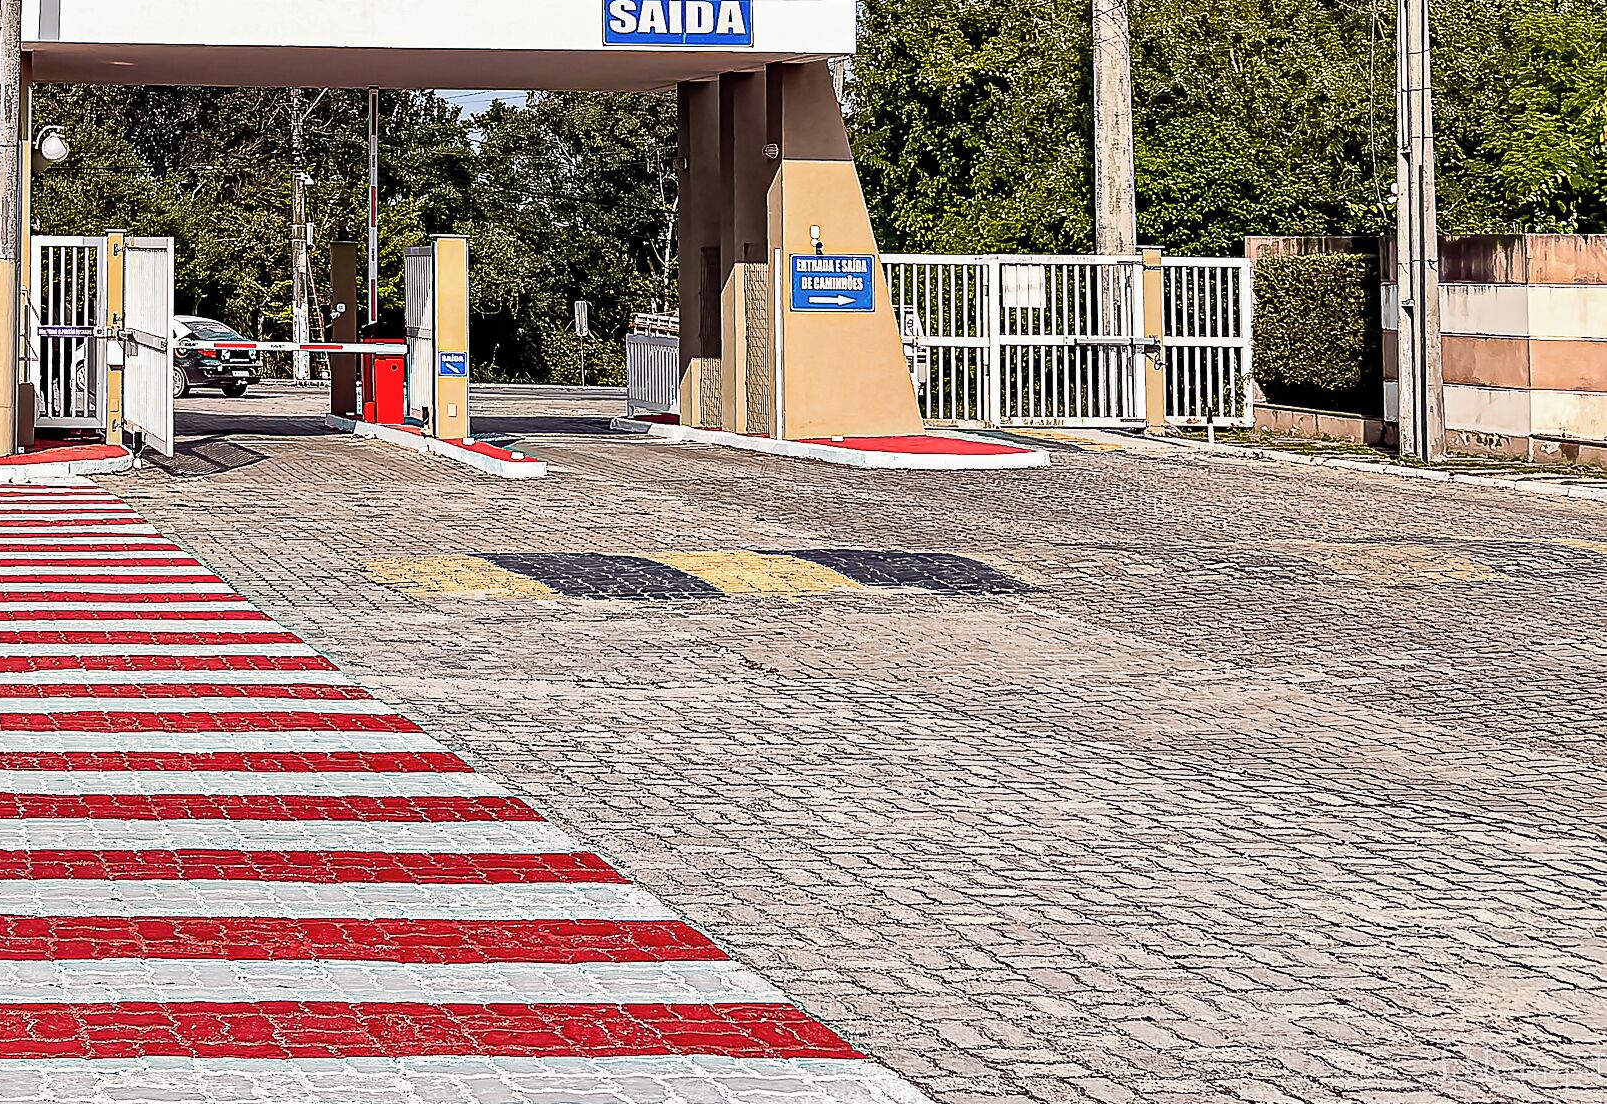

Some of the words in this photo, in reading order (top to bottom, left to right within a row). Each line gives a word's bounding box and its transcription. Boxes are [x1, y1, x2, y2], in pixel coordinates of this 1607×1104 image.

[796, 258, 834, 272] ENTRADA
[835, 259, 841, 272] E
[841, 257, 868, 273] SAÍDA
[801, 276, 813, 290] DE
[814, 274, 864, 291] CAMINHÕES
